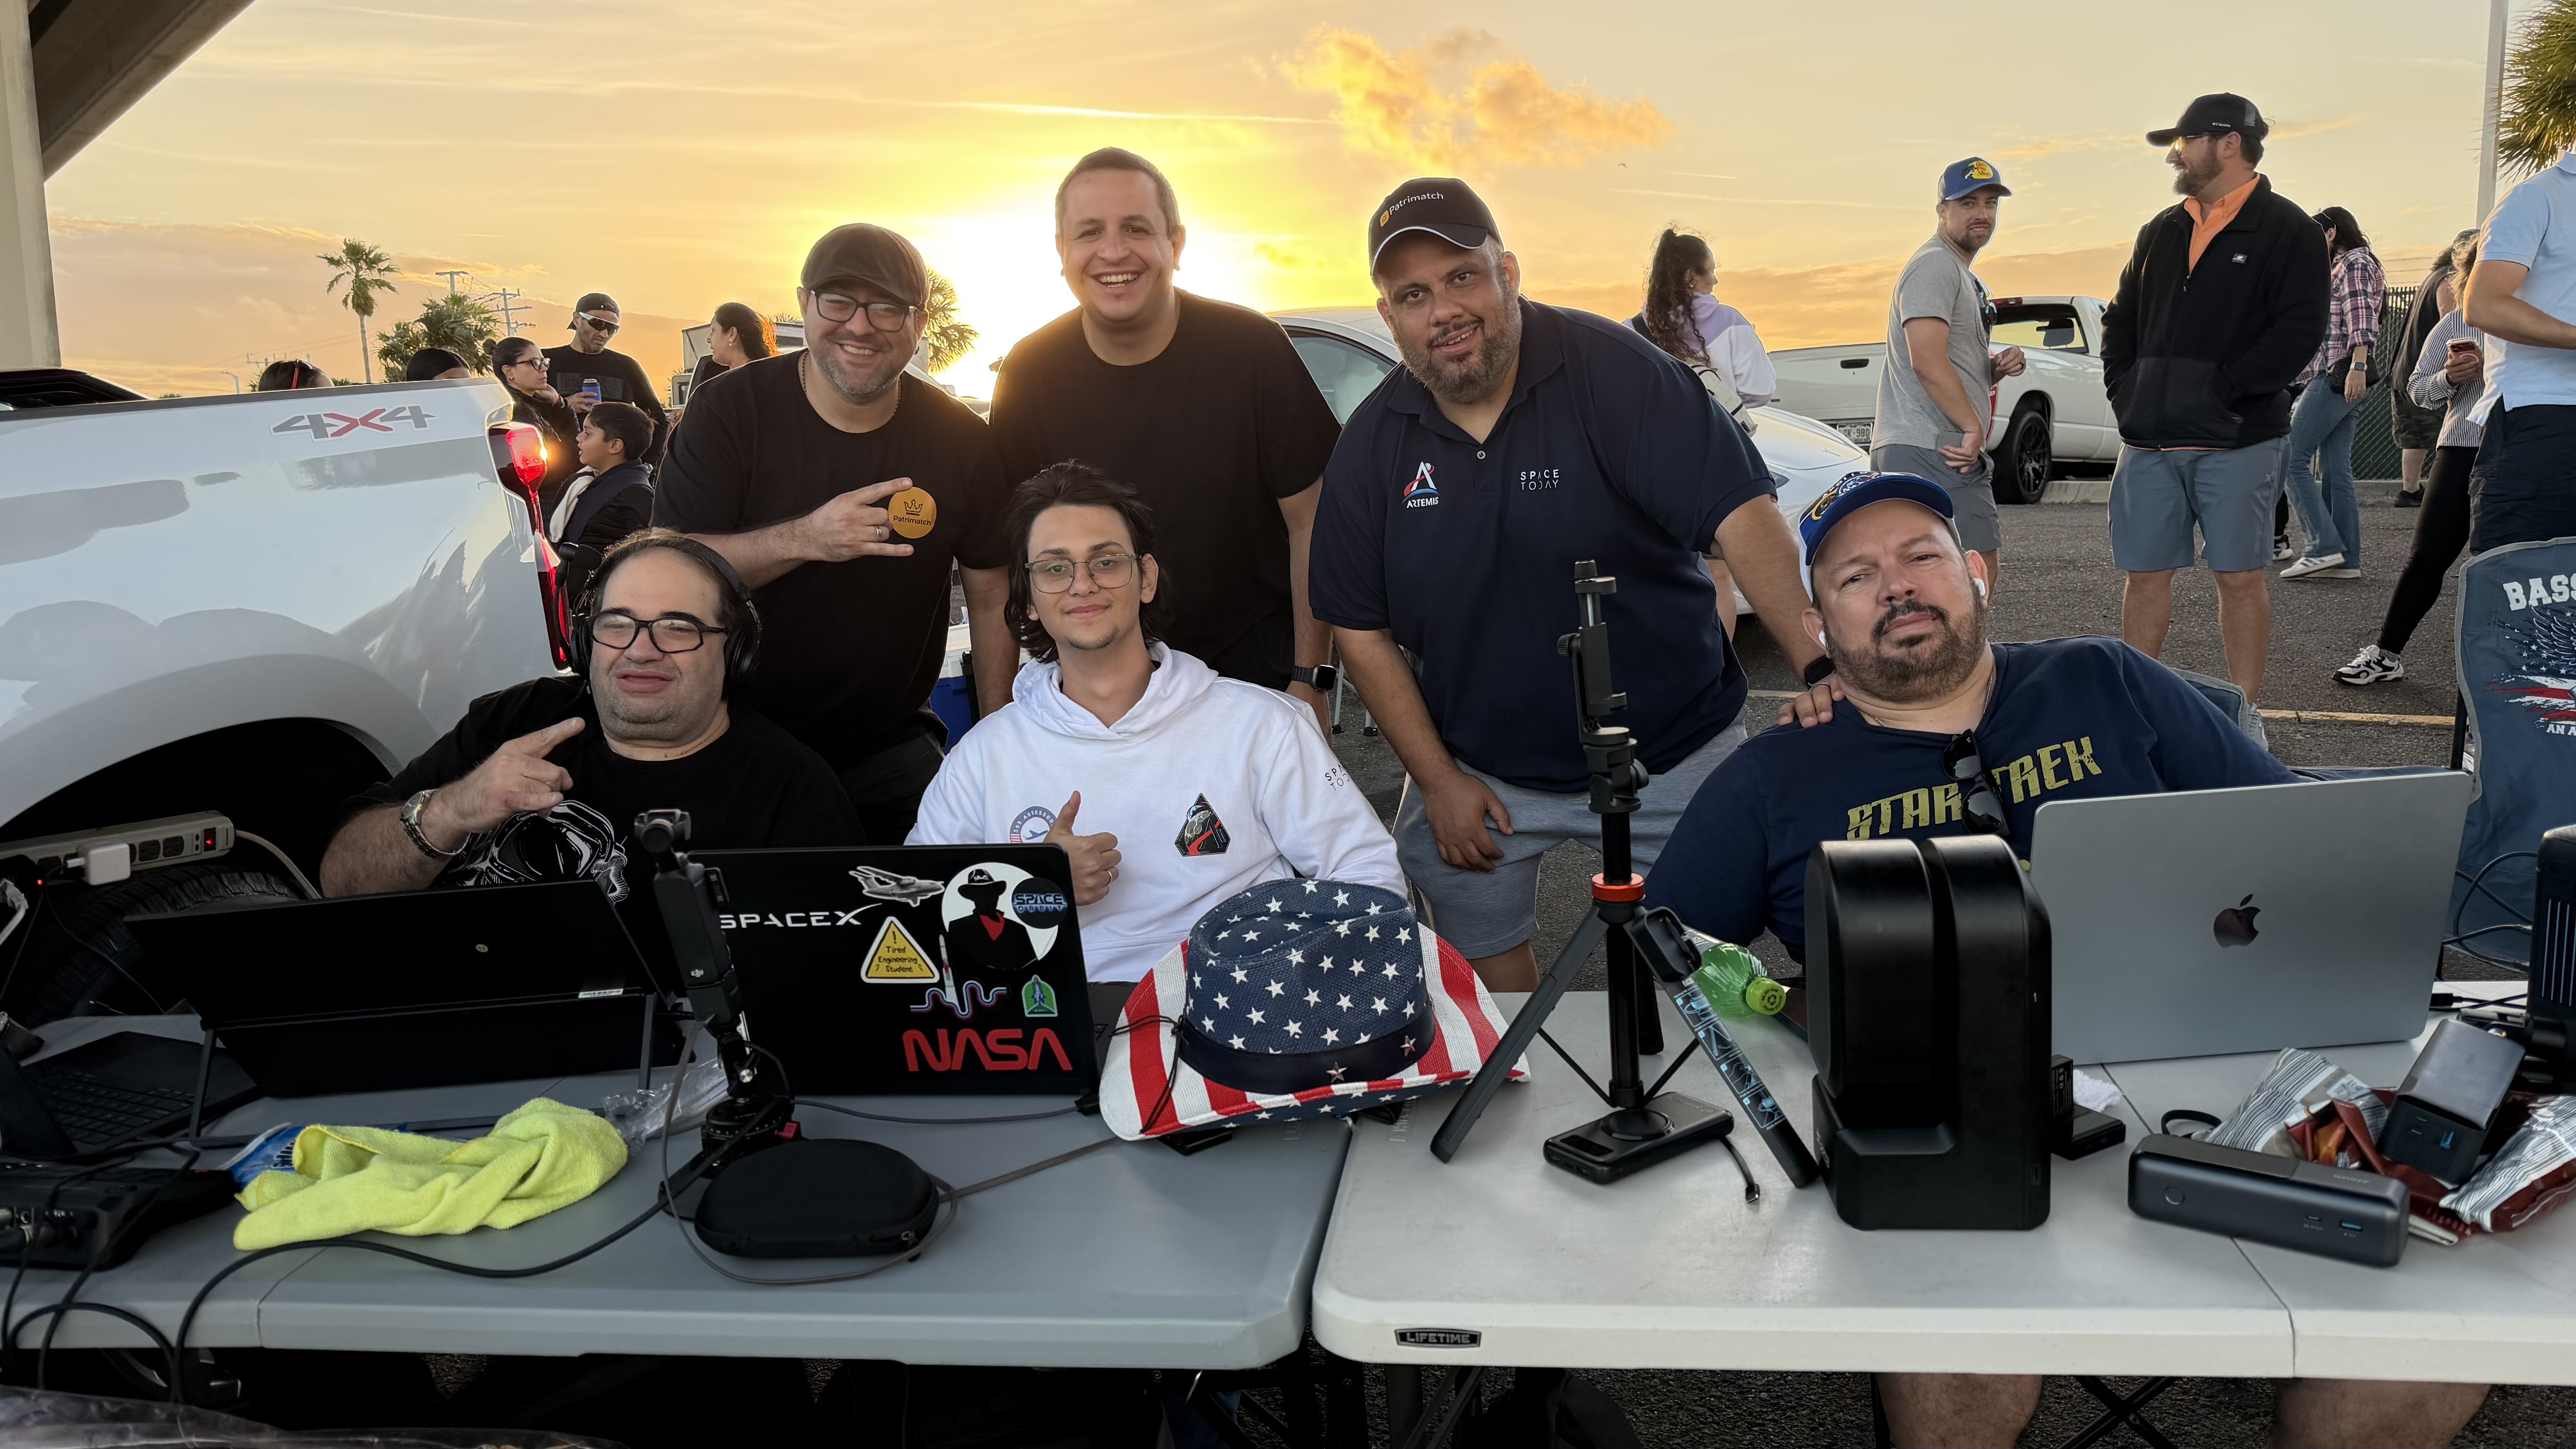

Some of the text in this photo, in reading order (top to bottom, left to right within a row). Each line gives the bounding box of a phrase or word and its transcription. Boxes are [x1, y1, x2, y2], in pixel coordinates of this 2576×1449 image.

[1389, 192, 1444, 215] Patrimatch
[1520, 469, 1559, 481] SPACE
[1520, 480, 1559, 491] TODAY
[1406, 497, 1439, 509] ARTEMIS
[893, 515, 931, 525] Patrimatch
[2546, 723, 2565, 735] AN
[1013, 810, 1054, 833] 365 ASSESSOR
[1015, 893, 1063, 905] SPACE
[719, 902, 883, 929] SPACEX
[878, 956, 918, 964] Engineering
[902, 1028, 1073, 1072] NASA
[1406, 1332, 1470, 1343] LIFETIME
